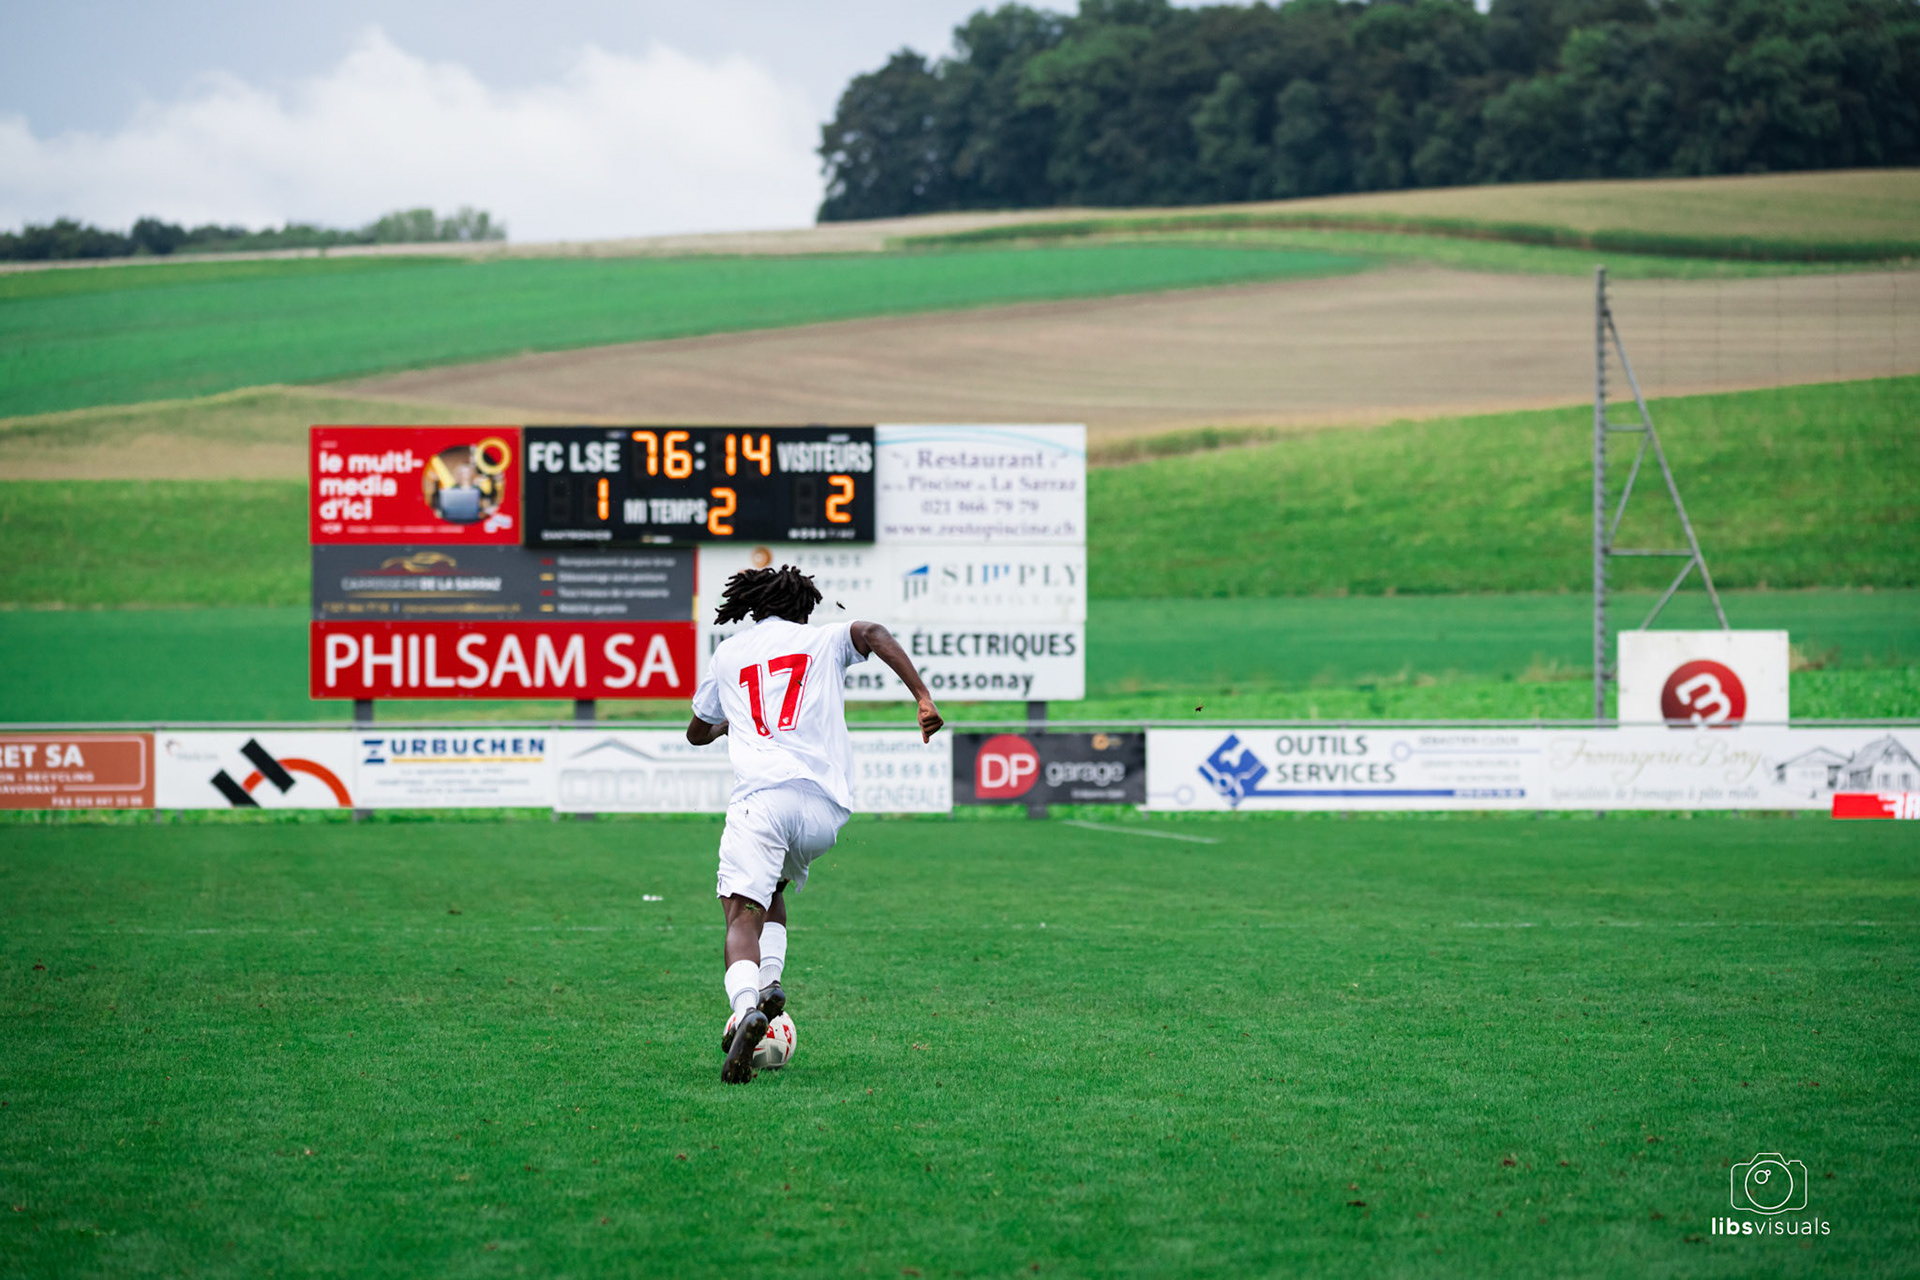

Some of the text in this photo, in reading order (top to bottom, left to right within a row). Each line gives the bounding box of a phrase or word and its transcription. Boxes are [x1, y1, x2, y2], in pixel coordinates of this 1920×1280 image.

[318, 449, 424, 473] le multi-
[529, 441, 621, 473] FC LSE
[777, 442, 873, 473] VISITEURS
[918, 450, 1043, 468] Restaurant
[318, 474, 397, 497] media
[908, 476, 972, 490] Piscine
[990, 476, 1012, 490] La
[1019, 476, 1077, 490] Sarraz
[597, 478, 609, 520] 1
[707, 487, 737, 535] 2
[825, 475, 854, 523] 2
[921, 499, 951, 514] 021
[623, 499, 708, 524] MI TEMPS
[911, 629, 1076, 661] ÉLECTRIQUES
[325, 633, 587, 688] PHILSAM
[603, 633, 680, 688] SA
[844, 673, 884, 690] ens
[739, 653, 813, 739] 17
[0, 744, 85, 768] ET SA
[363, 739, 545, 765] ZURBUCHEN
[1276, 735, 1368, 755] OUTILS
[25, 771, 96, 783] RECYCLING
[981, 753, 1125, 788] DP garage
[1276, 763, 1397, 783] SERVICES
[0, 784, 57, 795] AVORNAY
